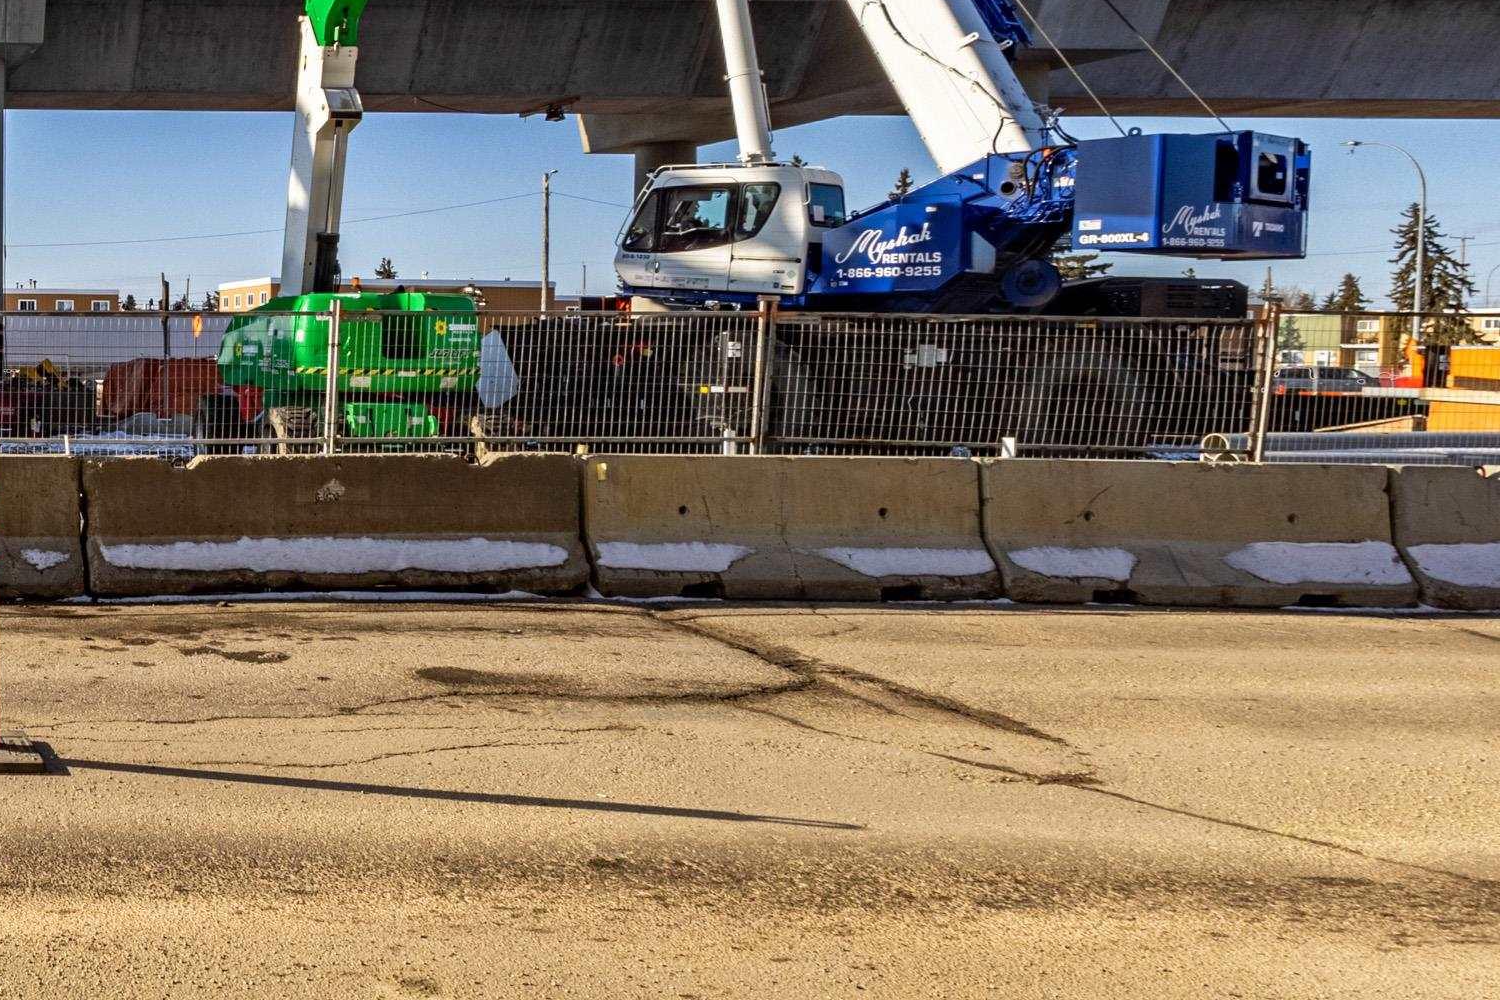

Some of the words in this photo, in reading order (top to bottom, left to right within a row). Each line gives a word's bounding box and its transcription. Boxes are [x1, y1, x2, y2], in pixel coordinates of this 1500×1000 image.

[1162, 203, 1221, 235] Myshak
[1193, 227, 1226, 237] RENTALS
[835, 222, 932, 264] Myshak
[881, 251, 942, 264] RENTALS
[836, 265, 942, 279] 1-866-960-9255
